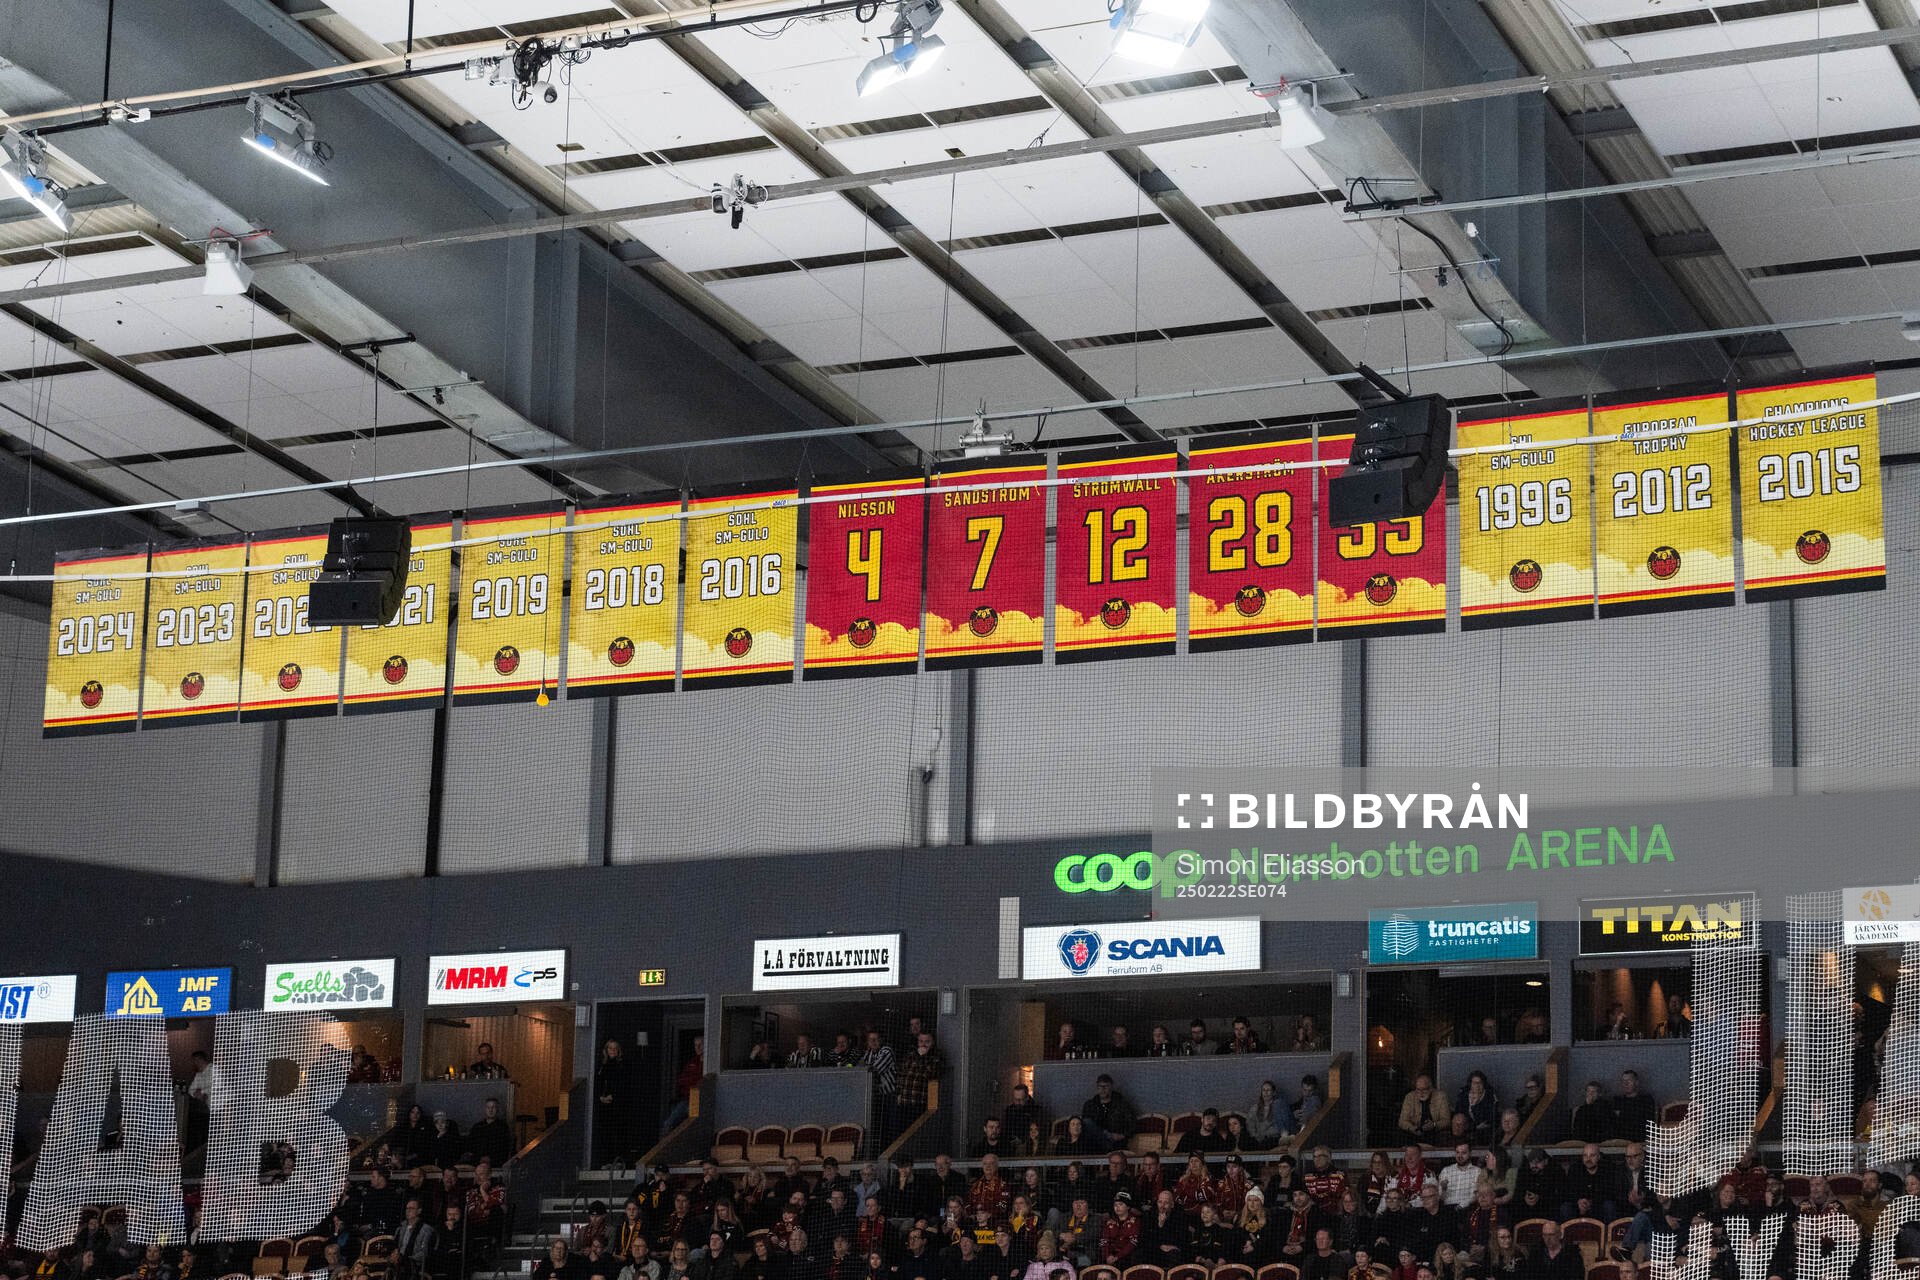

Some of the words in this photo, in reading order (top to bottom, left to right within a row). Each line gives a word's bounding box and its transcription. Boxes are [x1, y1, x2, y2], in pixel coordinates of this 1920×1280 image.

[1749, 420, 1805, 442] HOCKEY
[1810, 413, 1867, 434] LEAGUE
[1633, 435, 1688, 455] TROPHY
[1490, 449, 1556, 470] SM-GULD
[1758, 444, 1862, 503] 2015
[1475, 477, 1573, 532] 1996
[1612, 462, 1712, 520] 2012
[727, 511, 758, 527] SDHL
[838, 500, 896, 518] NILSSON
[715, 526, 770, 545] SM-GULD
[1082, 504, 1150, 585] 12
[1207, 489, 1294, 574] 28
[487, 548, 538, 565] SM-GULD
[600, 537, 653, 555] SM-GULD
[965, 514, 1005, 592] 7
[272, 568, 320, 585] SM-GULD
[700, 552, 783, 601] 2016
[846, 528, 884, 602] 4
[76, 588, 121, 605] SM-GULD
[175, 578, 222, 595] SM-GULD
[472, 573, 549, 620] 2019
[584, 563, 665, 611] 2018
[155, 602, 235, 648] 2023
[253, 594, 333, 638] 202
[57, 611, 135, 657] 2024
[1054, 849, 1206, 898] coop
[1230, 840, 1480, 886] Norrbotten
[1506, 823, 1676, 872] ARENA
[1428, 915, 1531, 938] truncatis
[1592, 901, 1742, 935] TITAN
[1107, 935, 1226, 961] SCANIA
[1429, 937, 1499, 947] FASTIGHETER
[1661, 931, 1742, 942] KONSTRUKTION
[789, 948, 890, 969] FÖRVALTNING
[1107, 965, 1148, 975] Ferruform
[1150, 964, 1163, 973] AB
[178, 976, 219, 993] JMF
[272, 969, 345, 1003] Snells
[445, 965, 508, 990] MRM
[0, 985, 35, 1020] IST
[181, 996, 212, 1012] AB
[0, 1010, 353, 1253] AB
